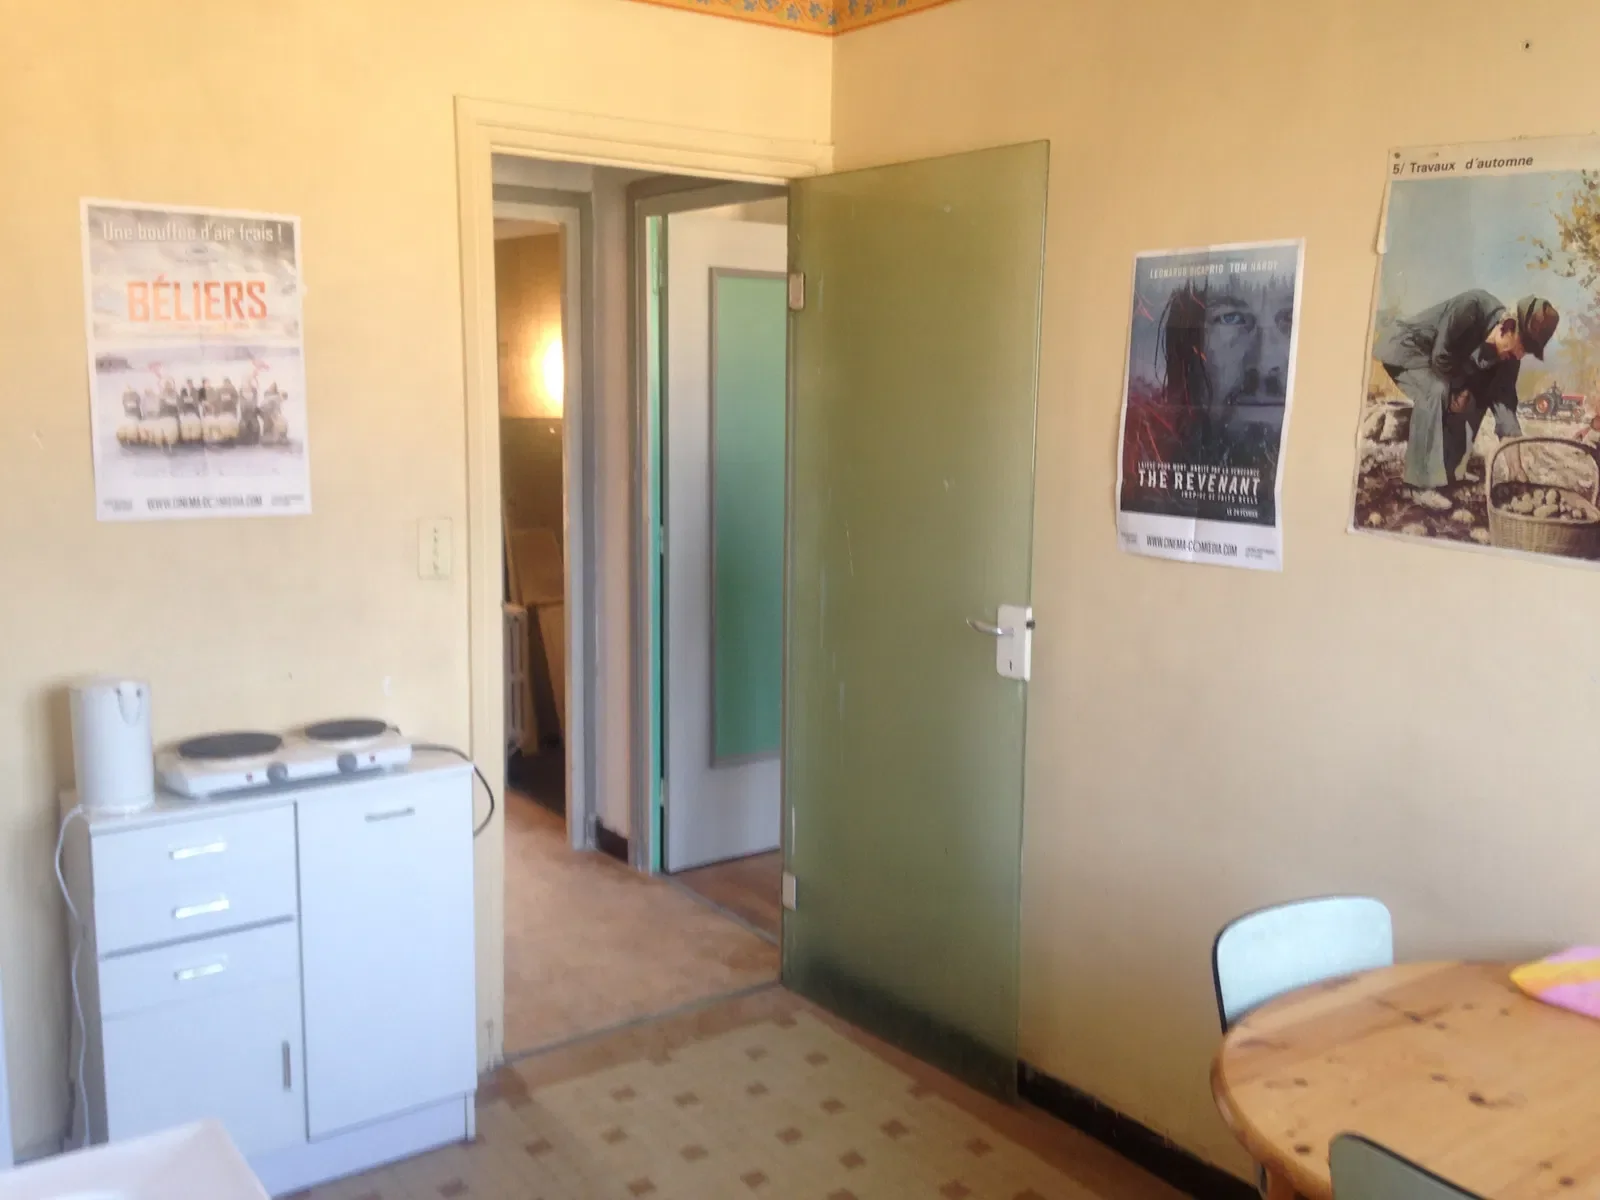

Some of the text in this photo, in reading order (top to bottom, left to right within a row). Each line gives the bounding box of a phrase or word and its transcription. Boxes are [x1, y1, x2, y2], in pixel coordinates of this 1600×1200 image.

[1410, 161, 1456, 174] Travaux
[1465, 156, 1534, 170] d'automne
[103, 220, 133, 241] Une
[200, 219, 235, 241] d'air
[240, 222, 274, 242] frais
[1149, 266, 1187, 280] LEONARDO
[1229, 261, 1248, 274] TOM
[1250, 260, 1279, 272] HARDY
[126, 273, 268, 322] BÉLIERS
[1138, 468, 1261, 496] THE REVENANT
